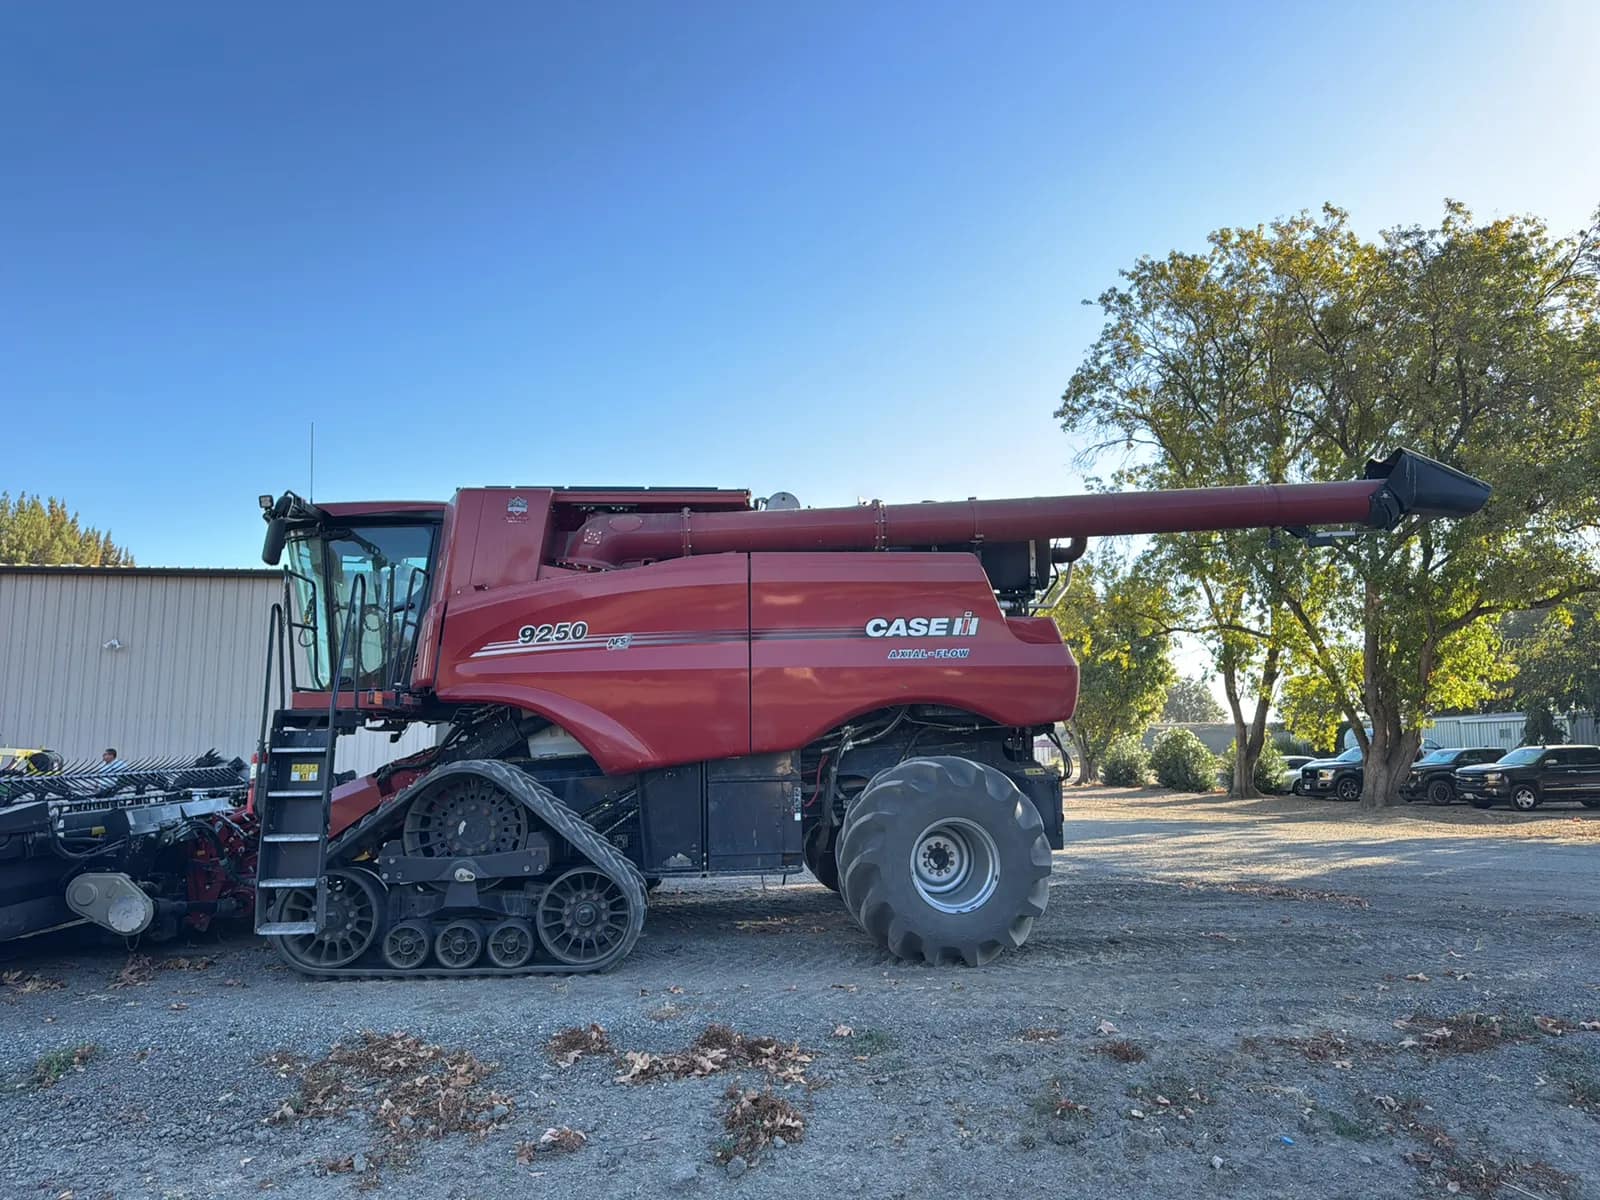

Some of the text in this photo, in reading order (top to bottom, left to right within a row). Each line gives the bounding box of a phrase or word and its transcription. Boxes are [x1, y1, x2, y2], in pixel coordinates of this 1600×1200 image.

[518, 621, 589, 644] 9250
[865, 617, 950, 637] CASE
[887, 648, 970, 660] AXIAL-FLOW
